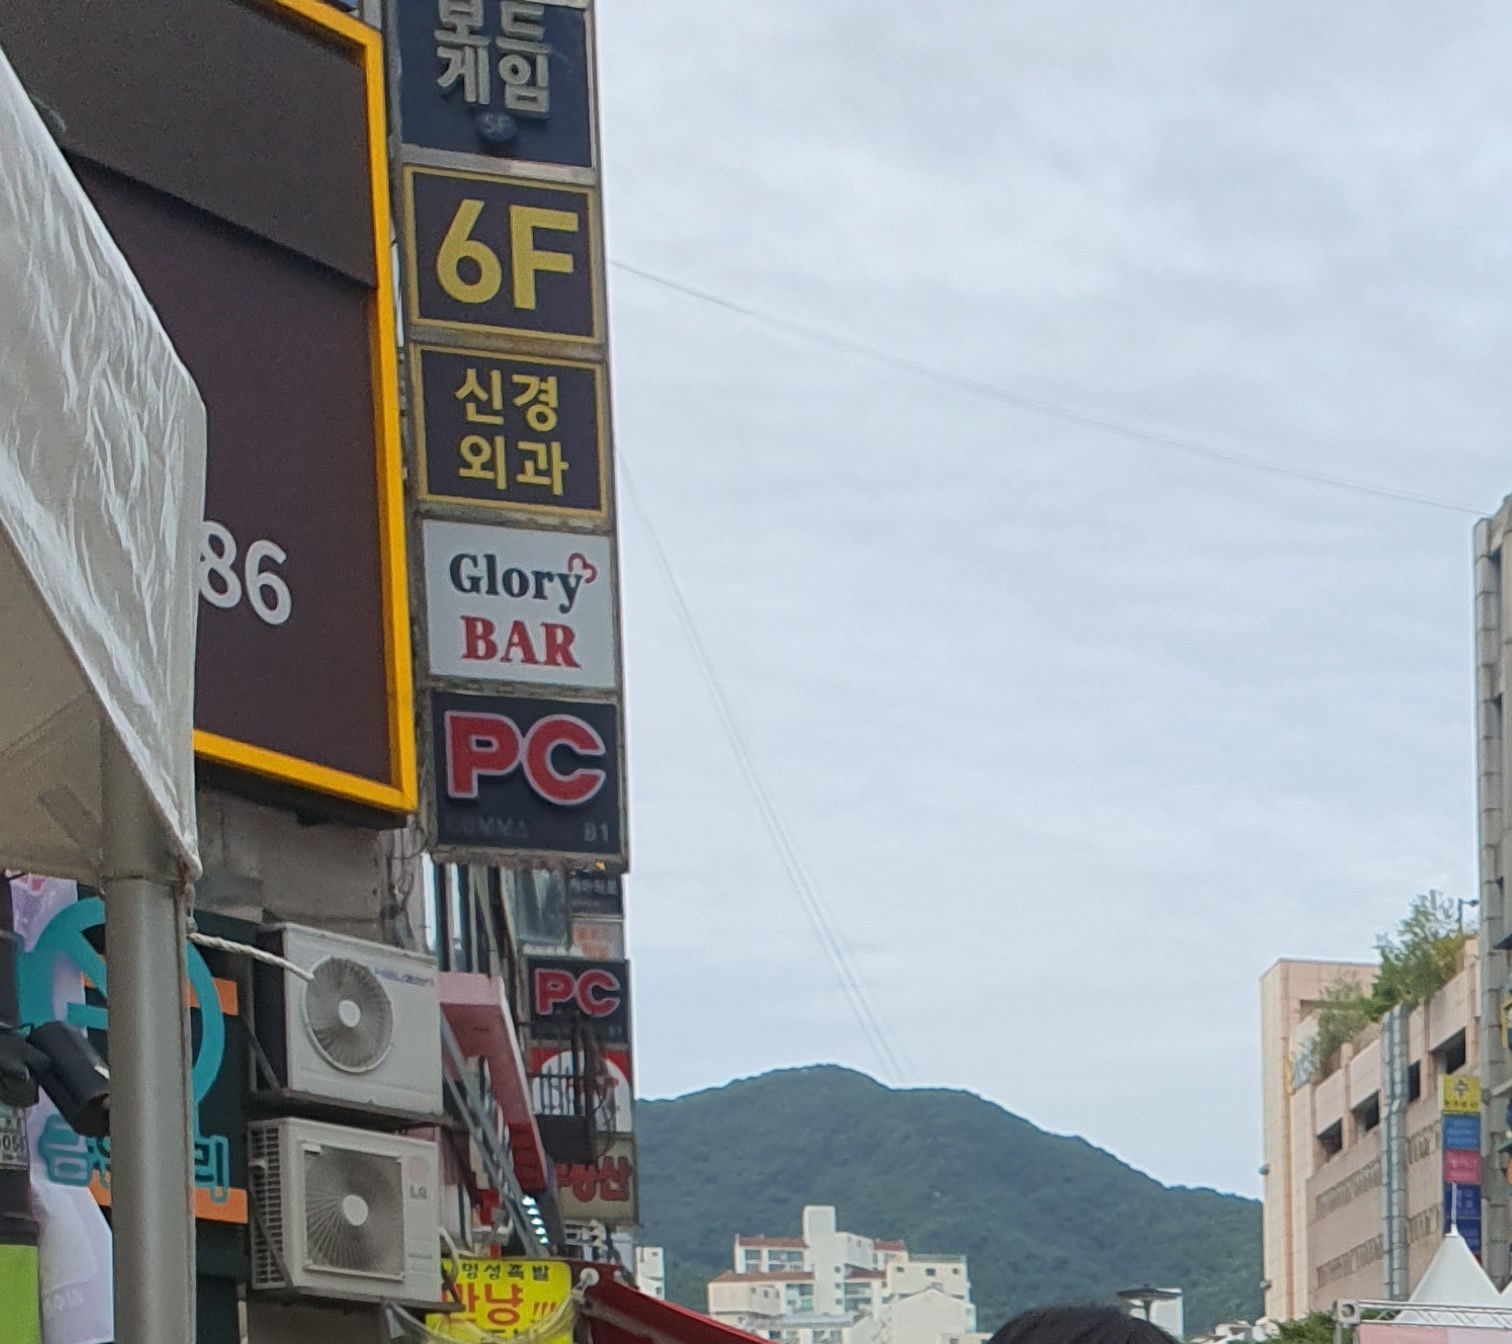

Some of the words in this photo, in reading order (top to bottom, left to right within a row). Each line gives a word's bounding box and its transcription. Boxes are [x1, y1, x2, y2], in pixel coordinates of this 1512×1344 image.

[437, 46, 550, 114] 게임
[437, 199, 579, 310] 6F
[455, 367, 560, 433] 신경
[458, 434, 569, 495] 외과
[448, 552, 584, 613] Glory
[461, 615, 583, 669] BAR
[444, 710, 607, 806] PC
[534, 968, 621, 1018] PC
